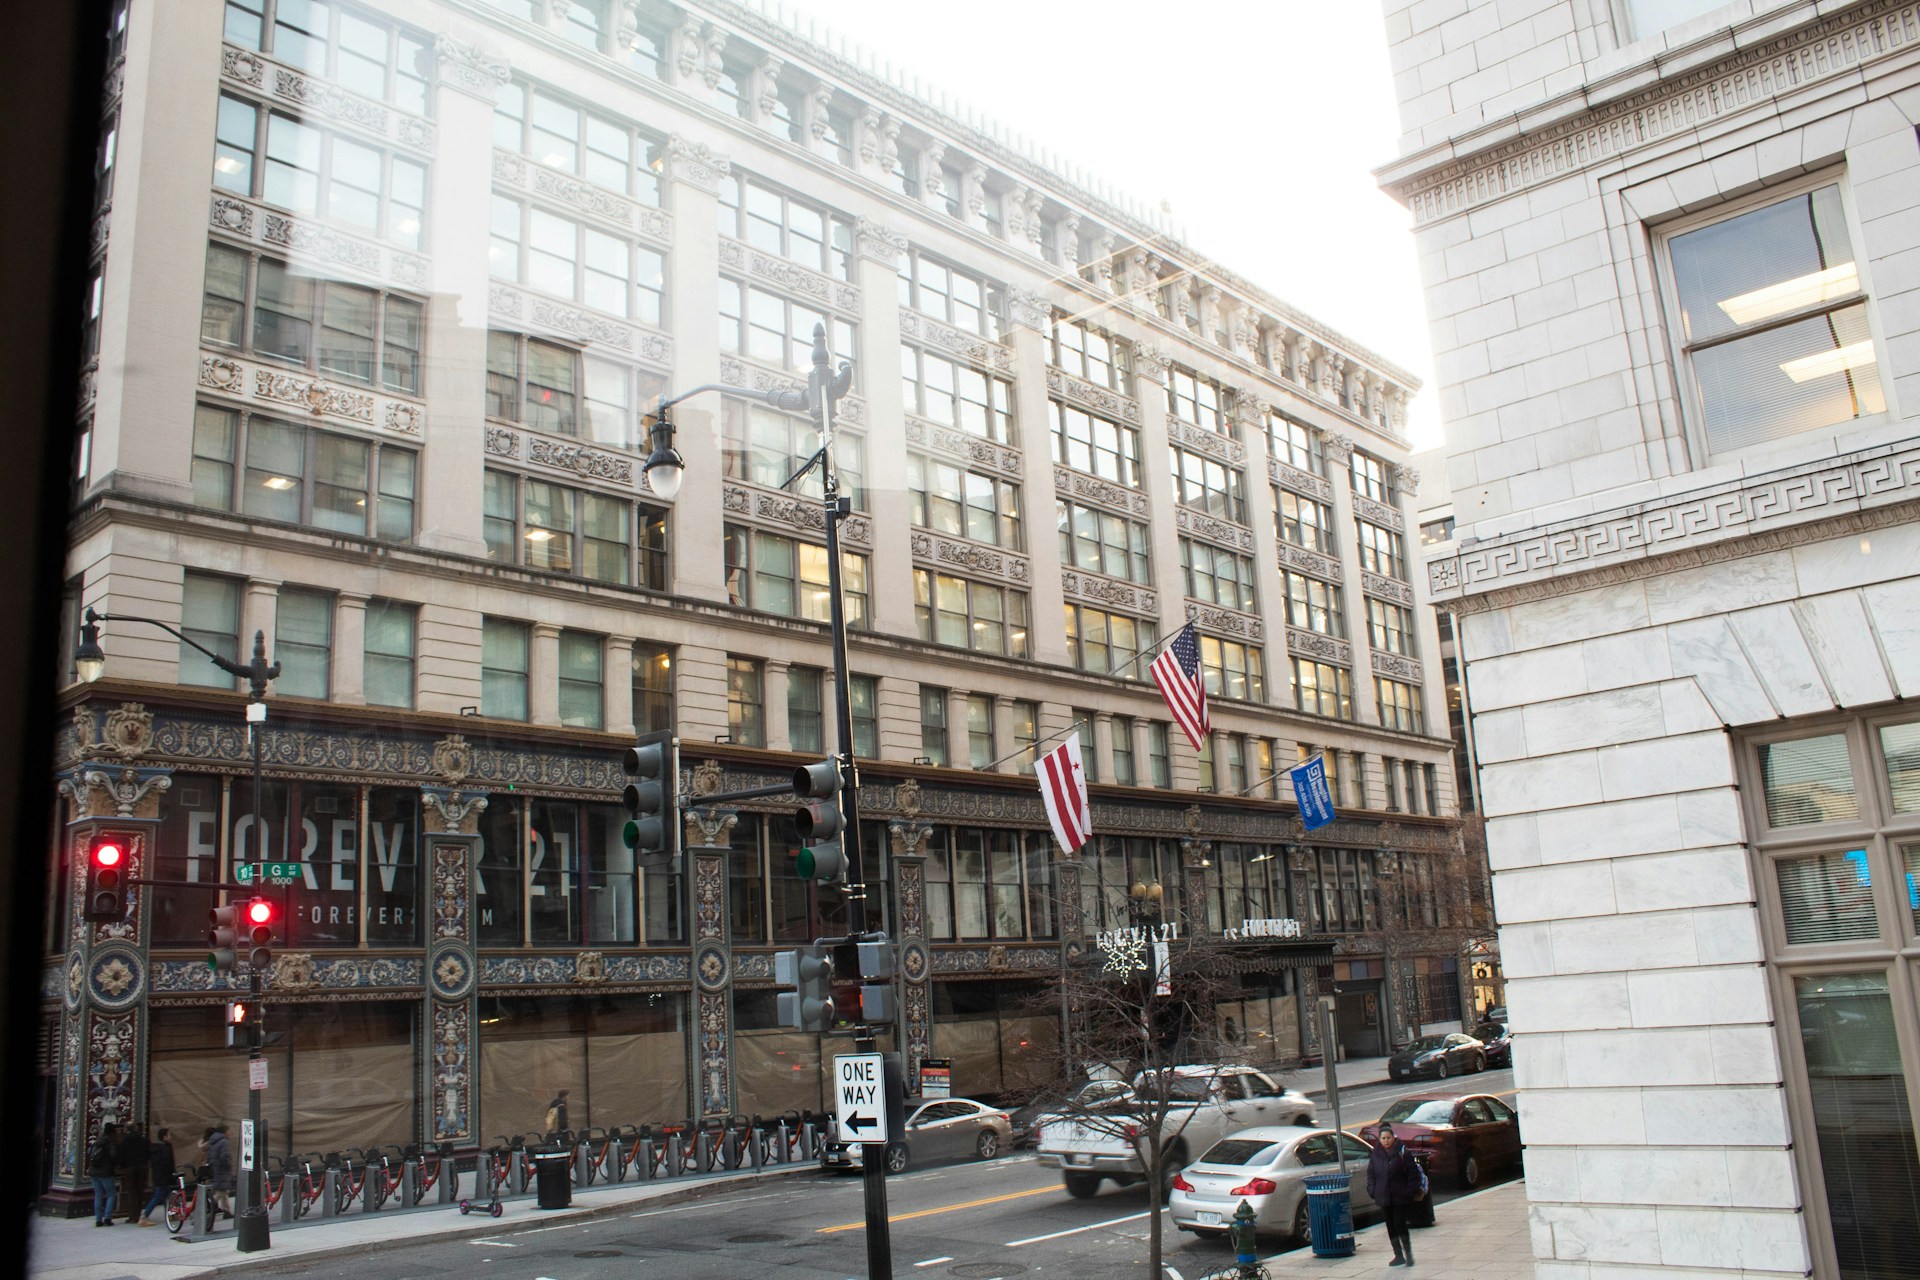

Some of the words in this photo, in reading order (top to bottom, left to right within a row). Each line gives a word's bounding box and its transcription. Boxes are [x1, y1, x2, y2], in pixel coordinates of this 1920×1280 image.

[187, 811, 486, 894] FOREV
[271, 865, 281, 876] G
[271, 877, 293, 885] 1000
[1161, 922, 1178, 941] 21
[843, 1062, 874, 1081] ONE
[843, 1086, 877, 1105] WAY
